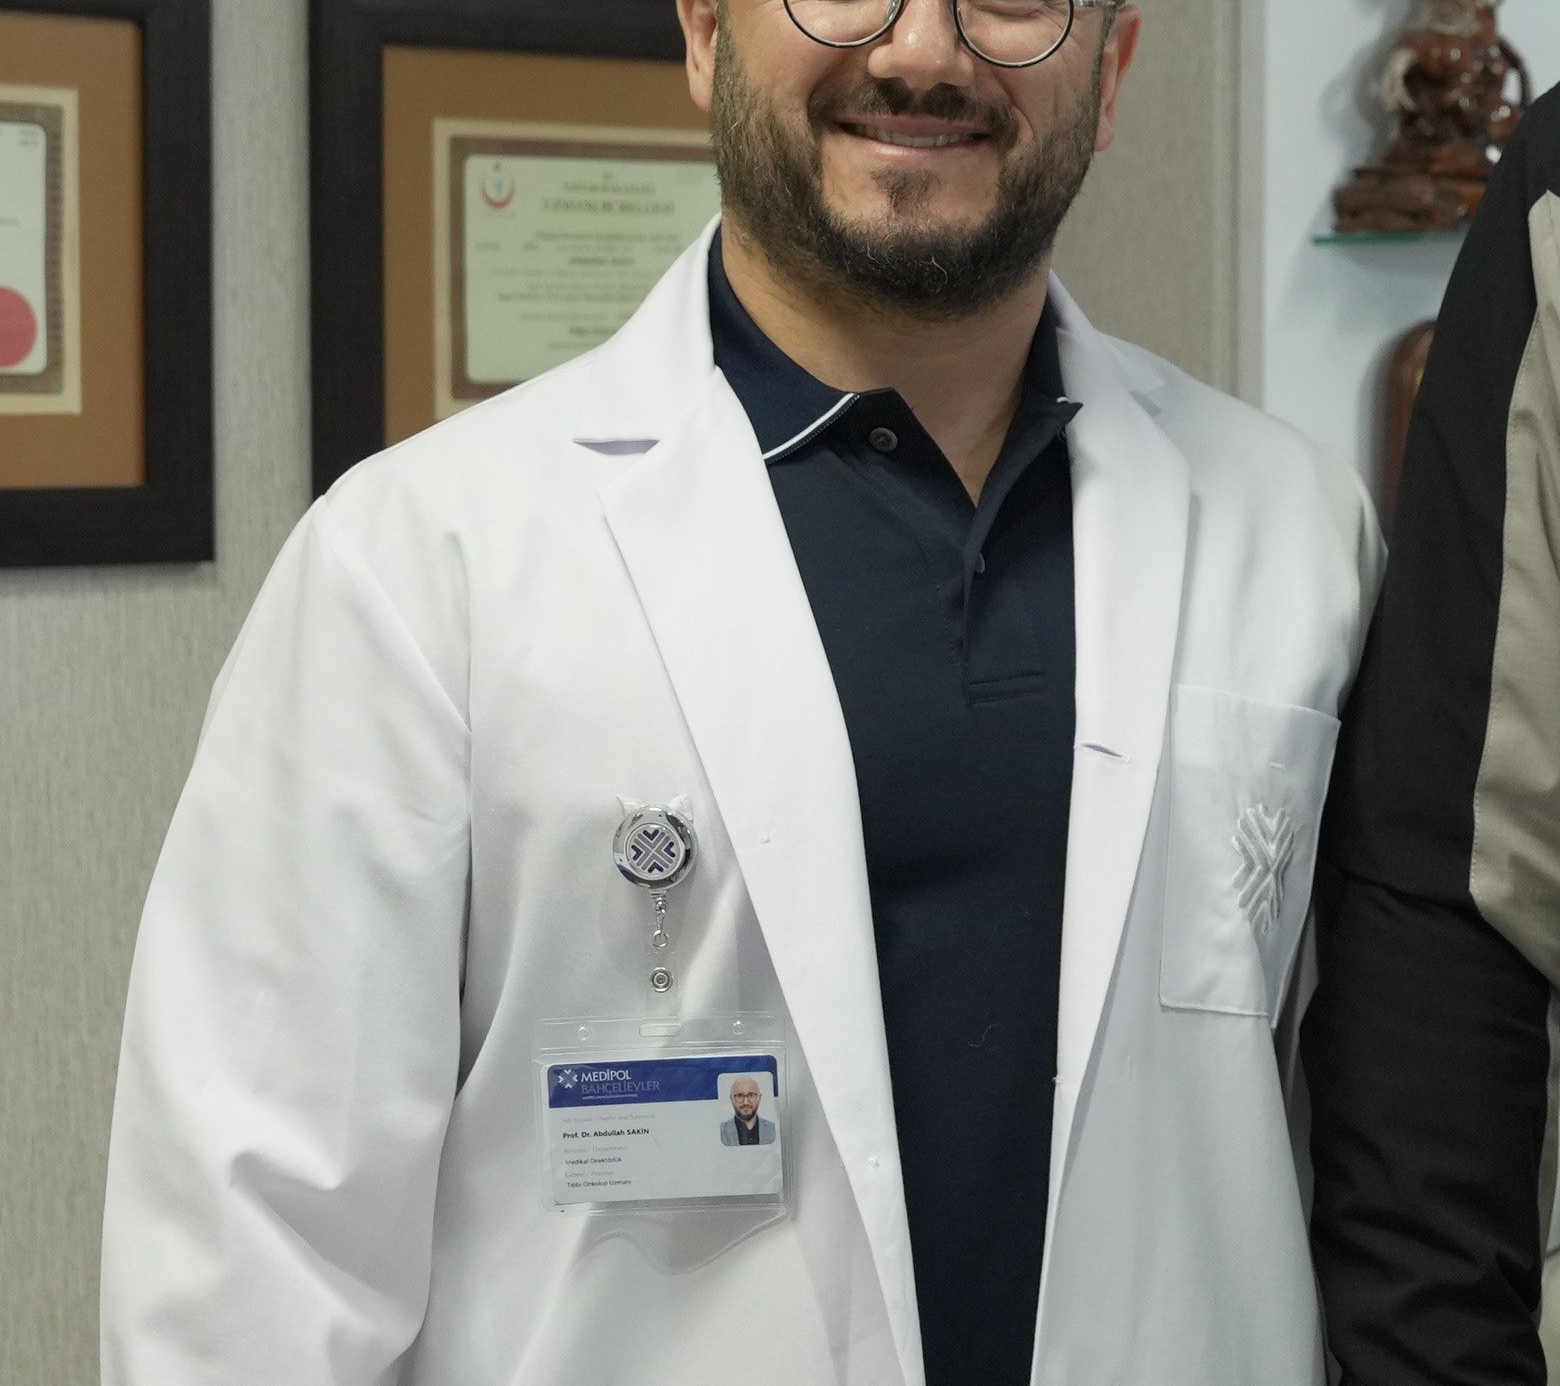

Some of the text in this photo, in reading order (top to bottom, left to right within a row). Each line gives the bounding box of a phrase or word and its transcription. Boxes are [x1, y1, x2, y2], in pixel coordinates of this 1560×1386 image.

[581, 1069, 631, 1083] MEDİPOL
[593, 1129, 625, 1138] Abdullah
[626, 1127, 650, 1136] SAKİN
